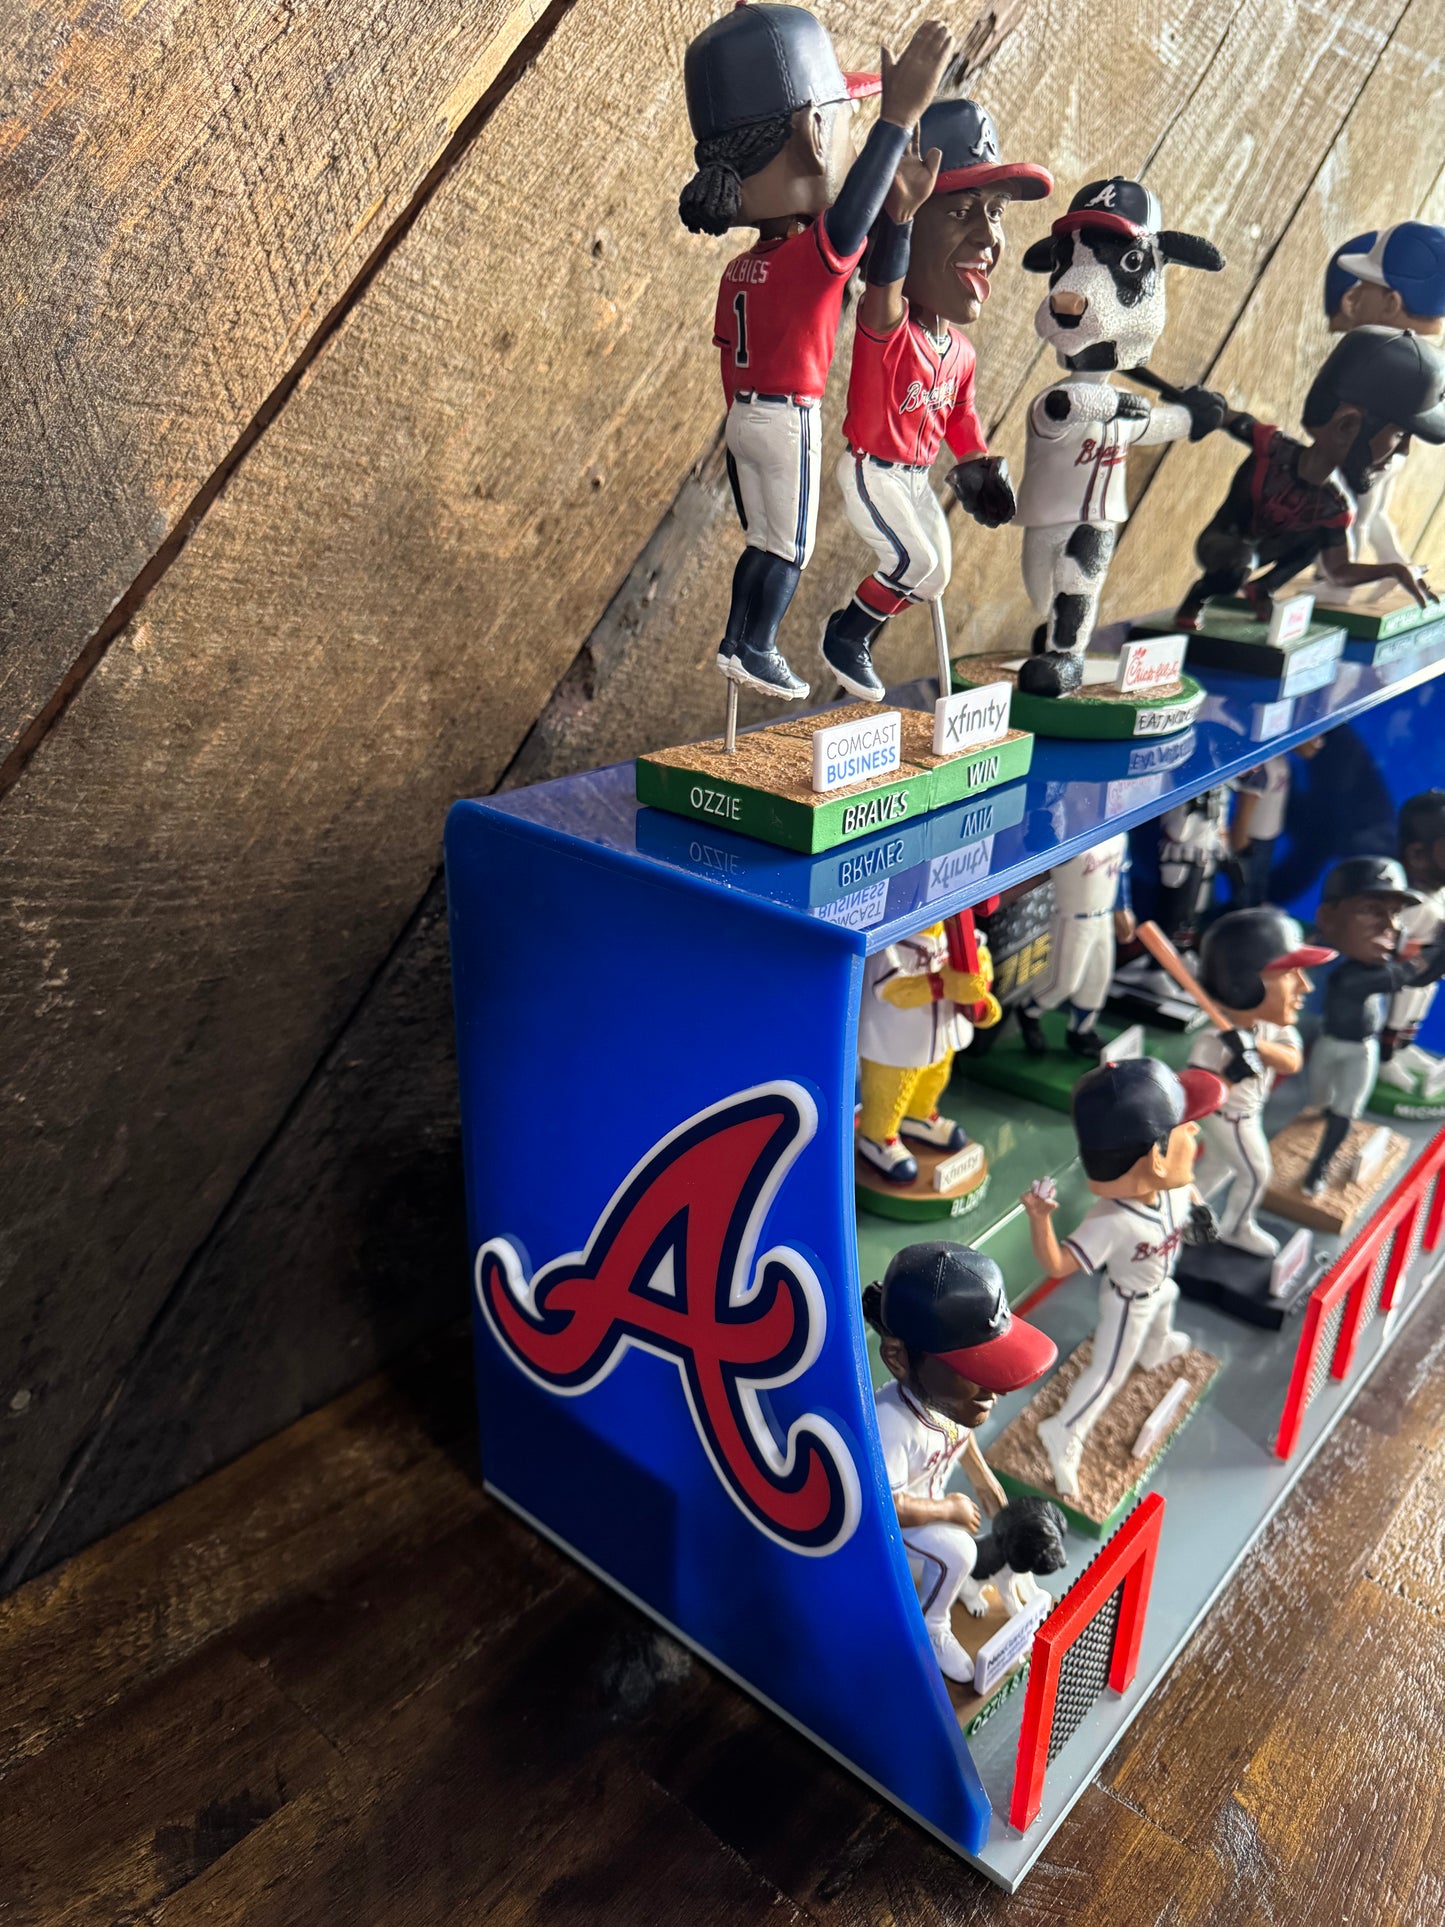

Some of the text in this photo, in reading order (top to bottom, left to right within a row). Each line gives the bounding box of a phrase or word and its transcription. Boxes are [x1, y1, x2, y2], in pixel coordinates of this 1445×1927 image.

[1084, 183, 1117, 208] A
[724, 260, 771, 284] ALBIES
[733, 290, 750, 368] 1
[945, 698, 1008, 743] xfinity
[826, 723, 897, 760] COMCAST
[826, 746, 897, 785] BUSINESS
[967, 756, 999, 789] WIN
[690, 786, 742, 821] OZZIE
[842, 790, 909, 834] BRAVES
[474, 1080, 862, 1558] A
